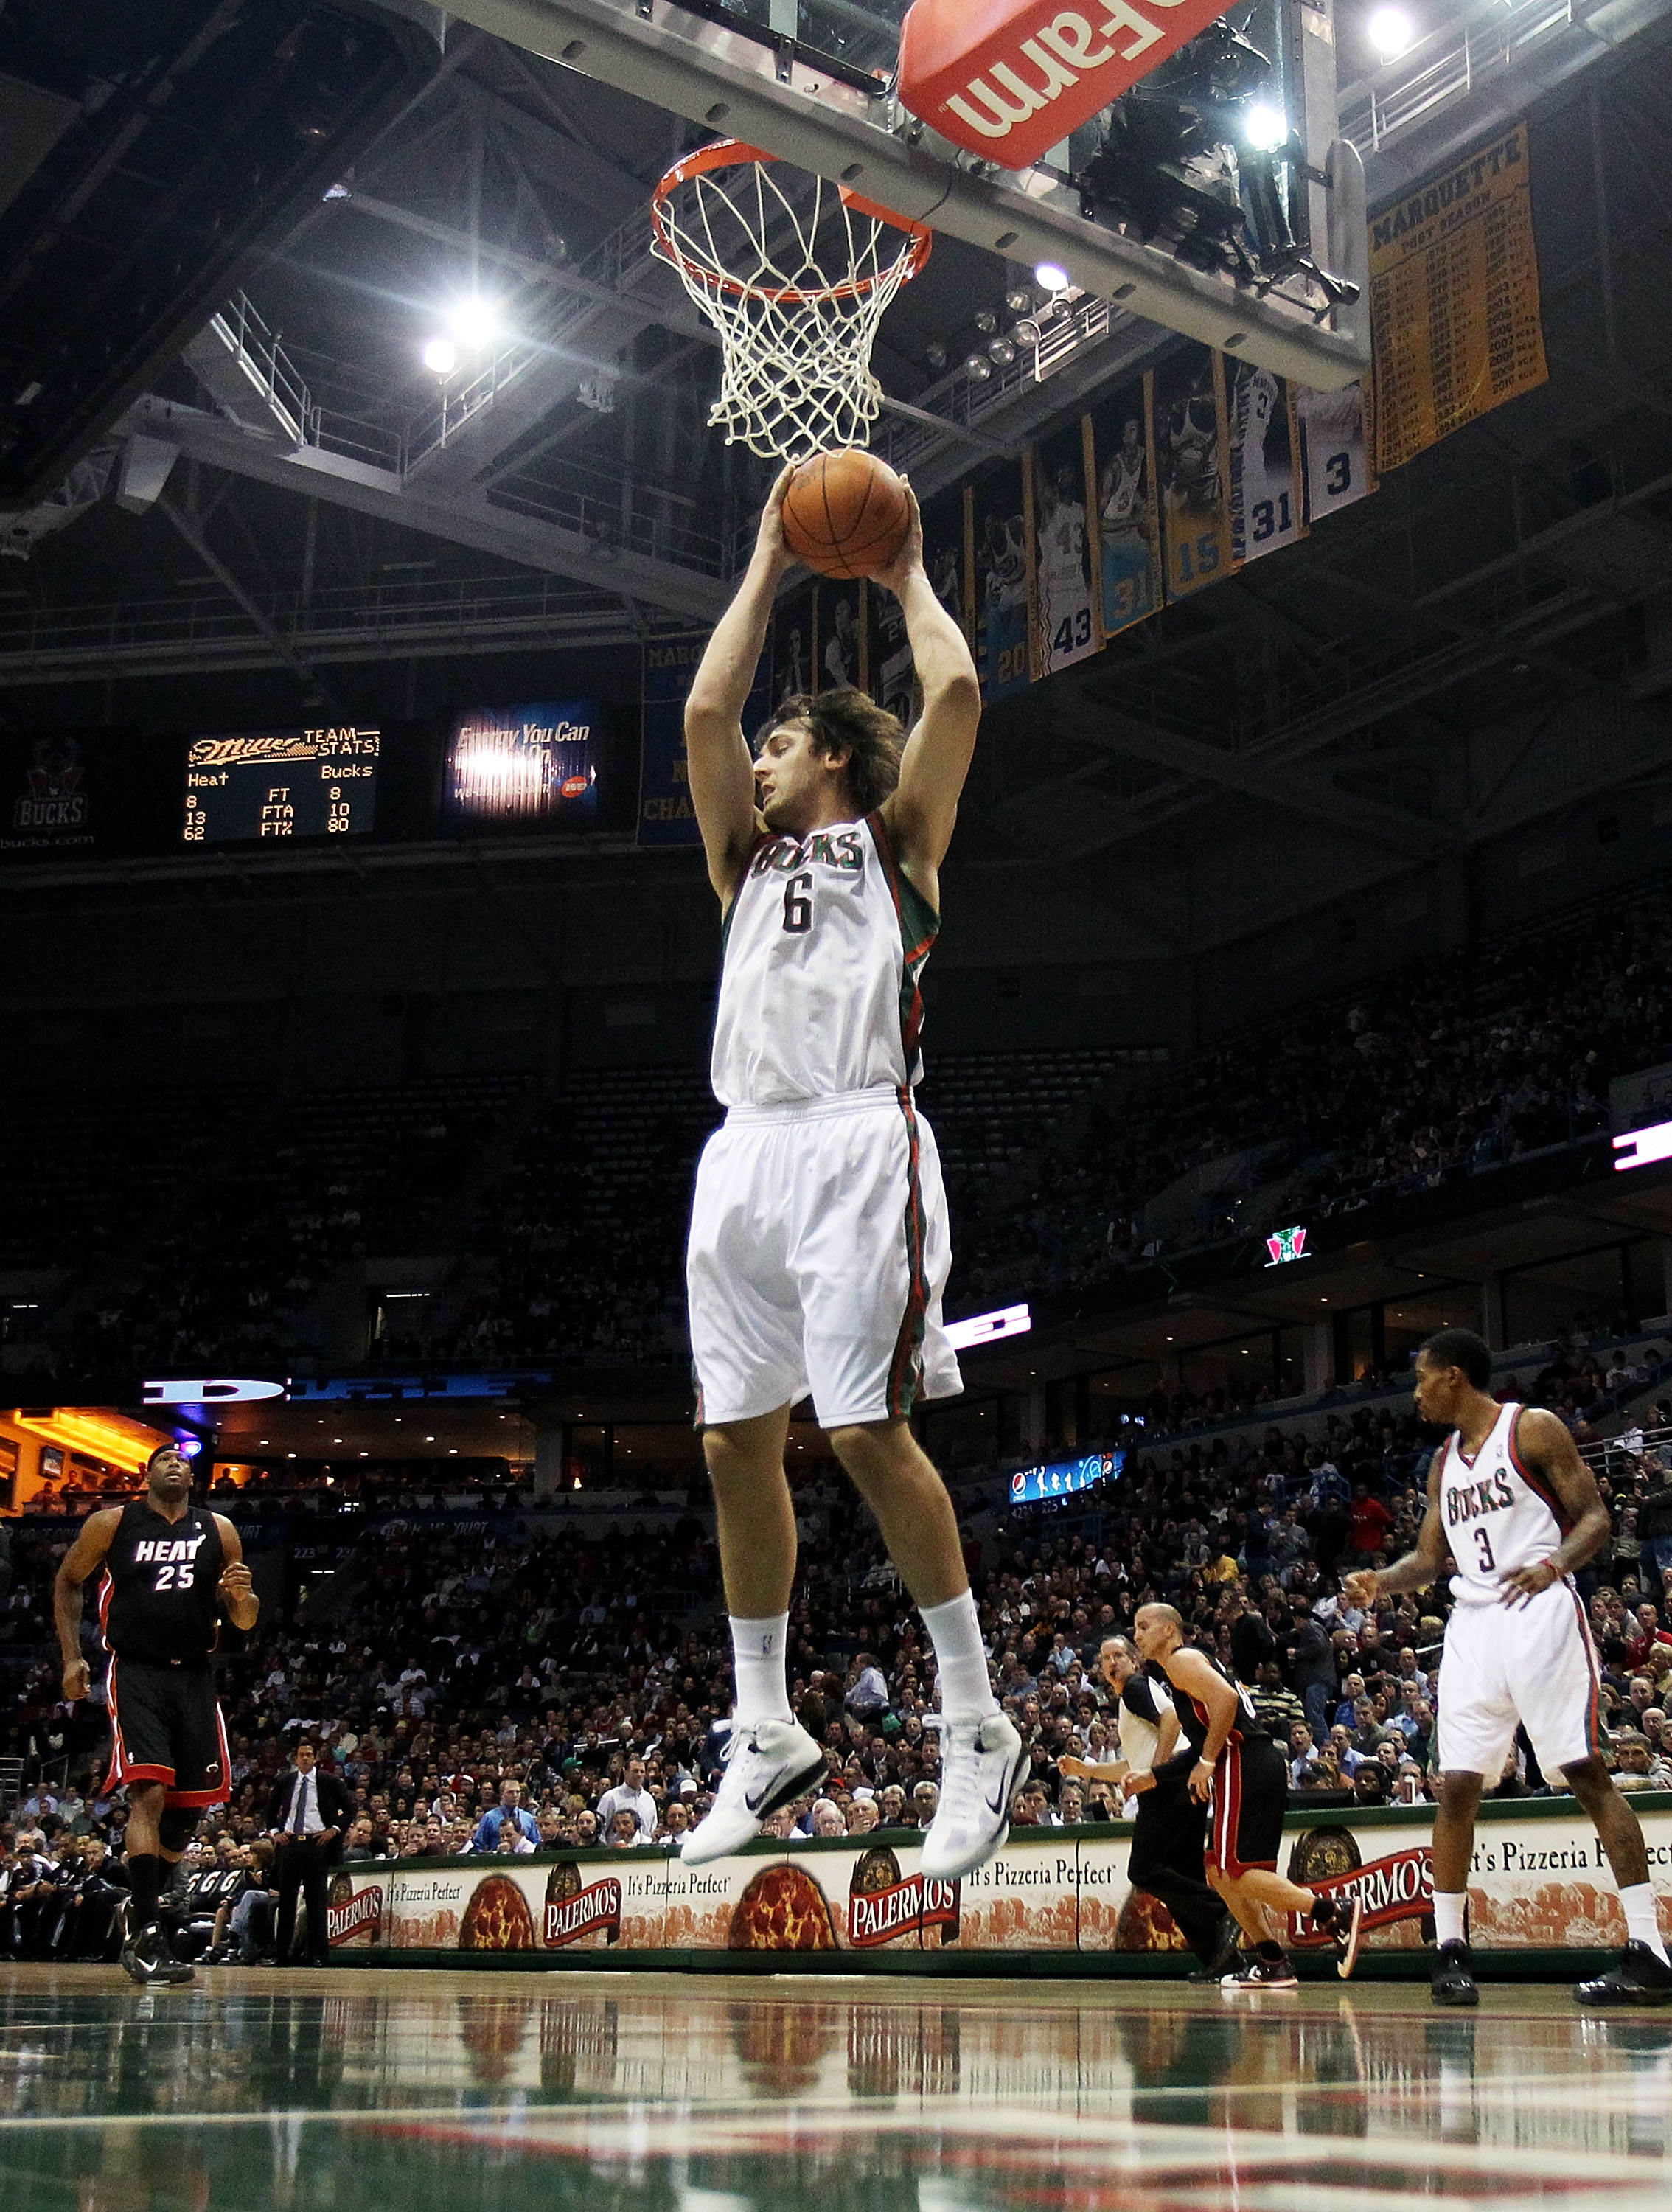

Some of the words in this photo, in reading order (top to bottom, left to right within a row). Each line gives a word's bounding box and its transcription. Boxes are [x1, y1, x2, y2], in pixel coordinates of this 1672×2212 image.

[945, 0, 1166, 138] Farm
[1373, 132, 1522, 252] MARQUETTE
[1327, 453, 1351, 496] 3
[1253, 492, 1292, 541] 31
[1180, 532, 1219, 581] 15
[1053, 608, 1091, 654] 43
[304, 728, 357, 742] TEAM
[318, 740, 374, 757] STATS
[523, 723, 553, 744] You
[555, 721, 590, 742] Can
[188, 771, 229, 787] Heat
[321, 764, 373, 779] Bucks
[187, 795, 197, 810] 8
[268, 787, 290, 802] FT
[330, 786, 341, 800] 8
[187, 811, 206, 826] 13
[262, 804, 293, 820] FTA
[330, 802, 349, 817] 10
[184, 826, 204, 841] 62
[261, 821, 293, 836] FT%
[328, 818, 349, 833] 80
[752, 832, 863, 879] BUKS
[783, 872, 812, 933] 6
[136, 1534, 206, 1562] HEAT
[1474, 1527, 1496, 1573] 3
[155, 1564, 194, 1591] 25
[1502, 1839, 1587, 1872] Pizzeria
[628, 1875, 643, 1896] It's
[646, 1874, 686, 1895] Pizzeria
[689, 1873, 728, 1894] Perfect
[995, 1861, 1051, 1886] Pizzeria
[1056, 1859, 1112, 1885] Perfect
[433, 1882, 461, 1900] Perfect
[853, 1877, 955, 1938] PALERMOS
[327, 1887, 380, 1940] PALERMO'S
[546, 1879, 618, 1939] PALERMO'S
